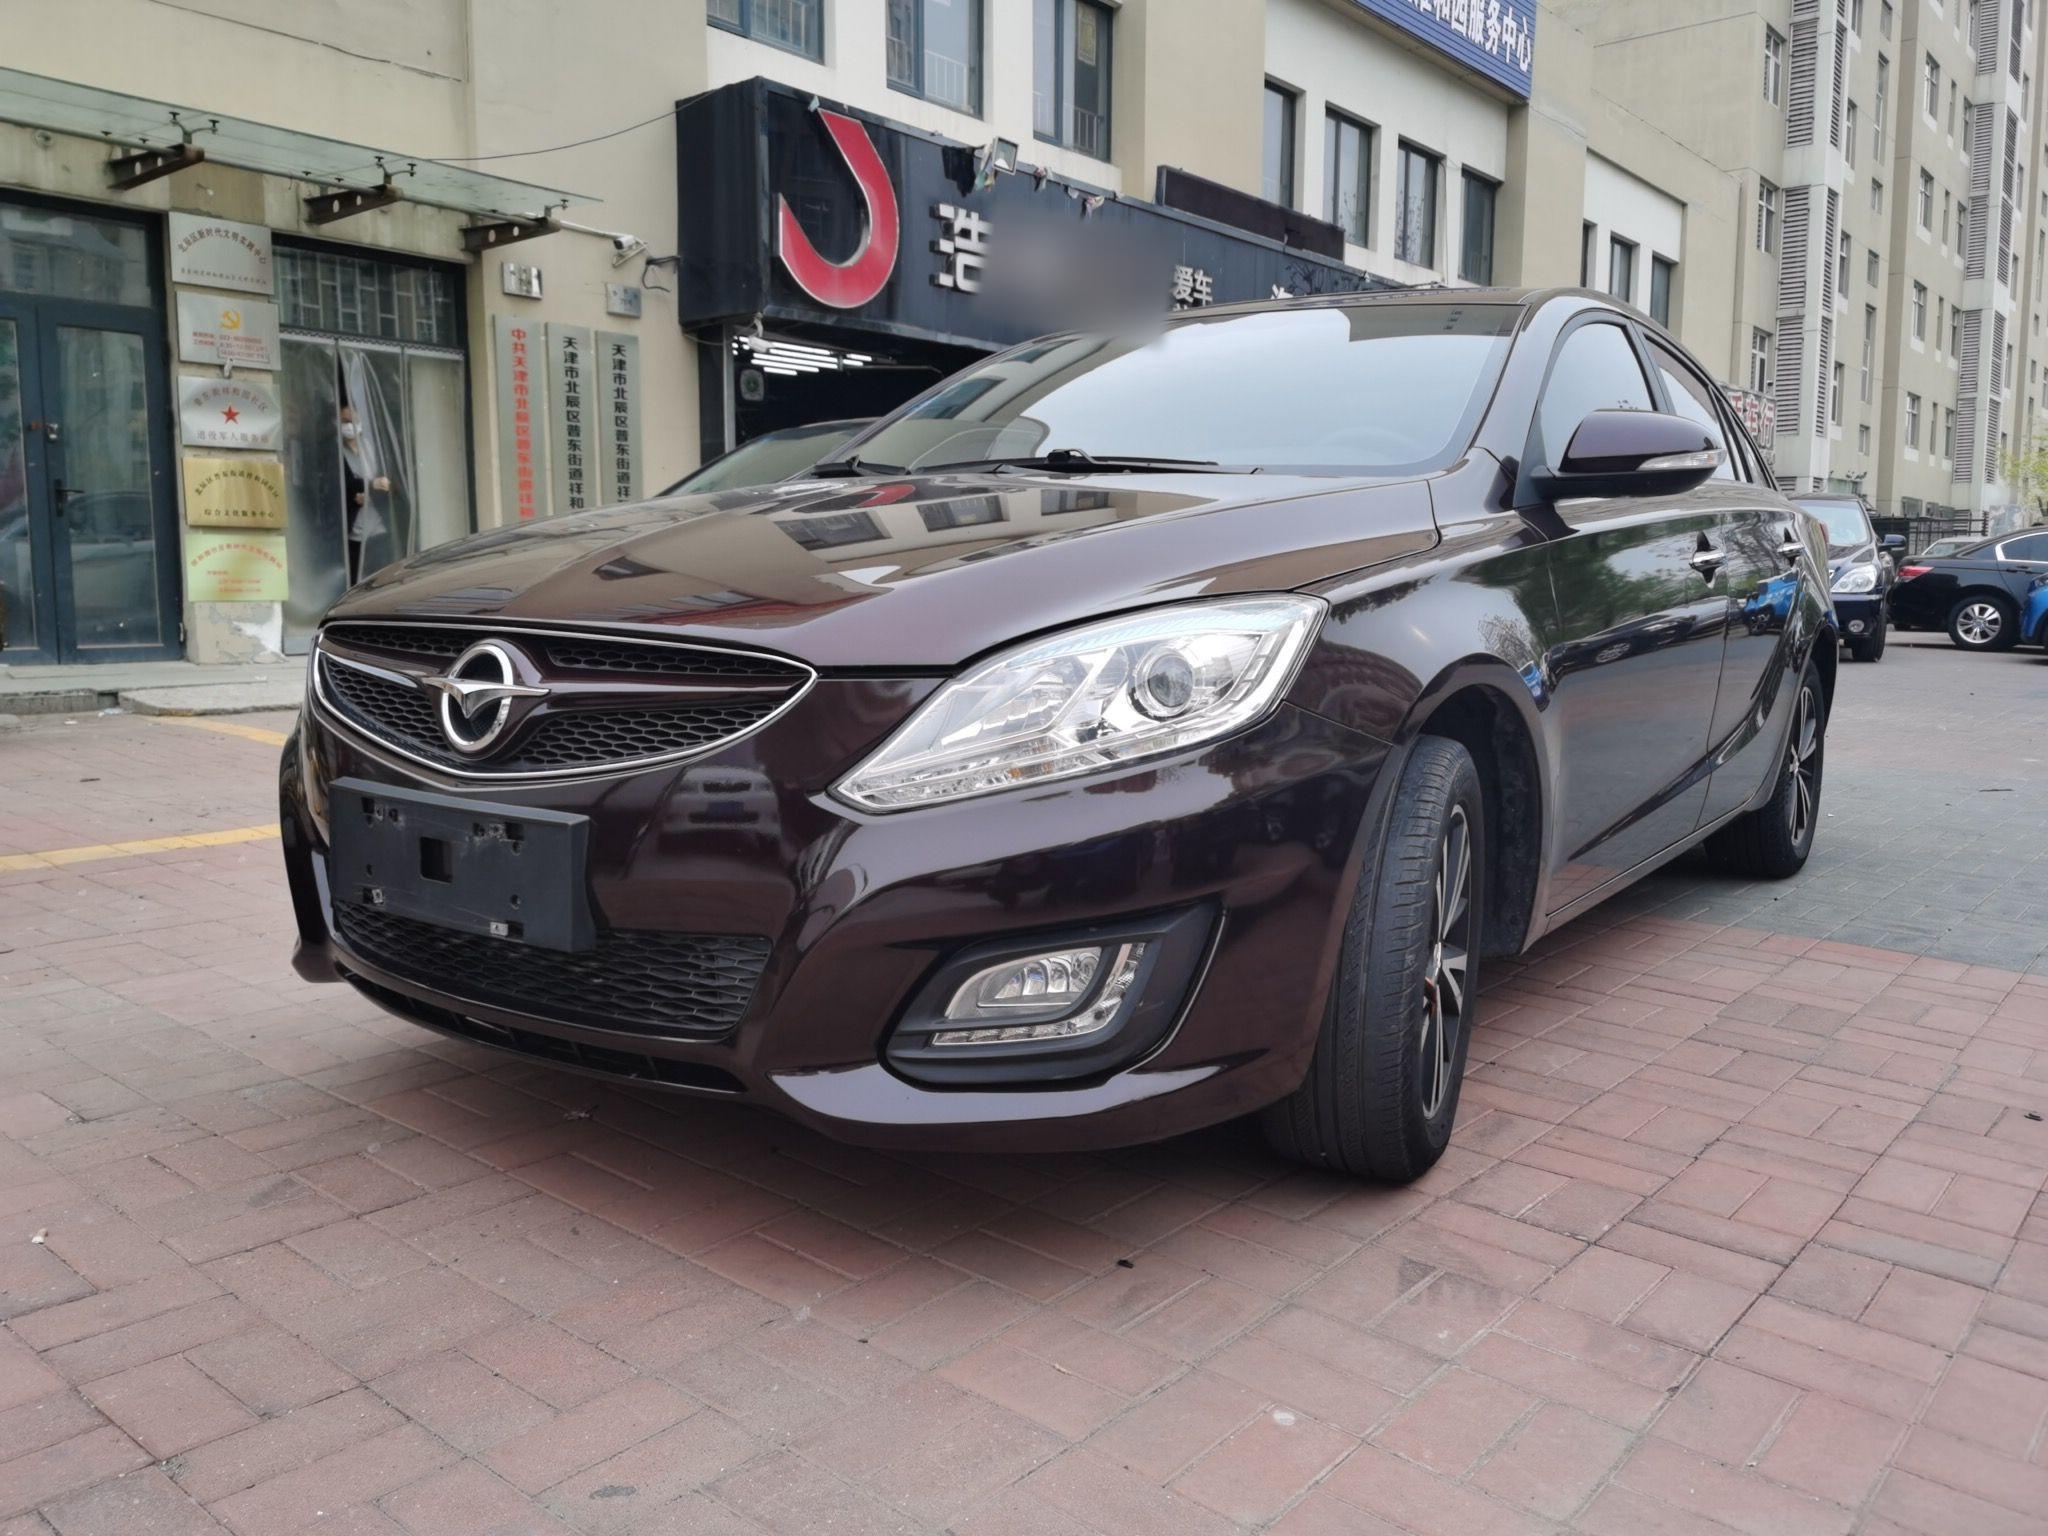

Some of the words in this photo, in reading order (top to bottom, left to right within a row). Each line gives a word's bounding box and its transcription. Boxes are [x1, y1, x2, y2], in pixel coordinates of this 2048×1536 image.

[611, 343, 631, 503] 天津市北辰区普东街道祥
